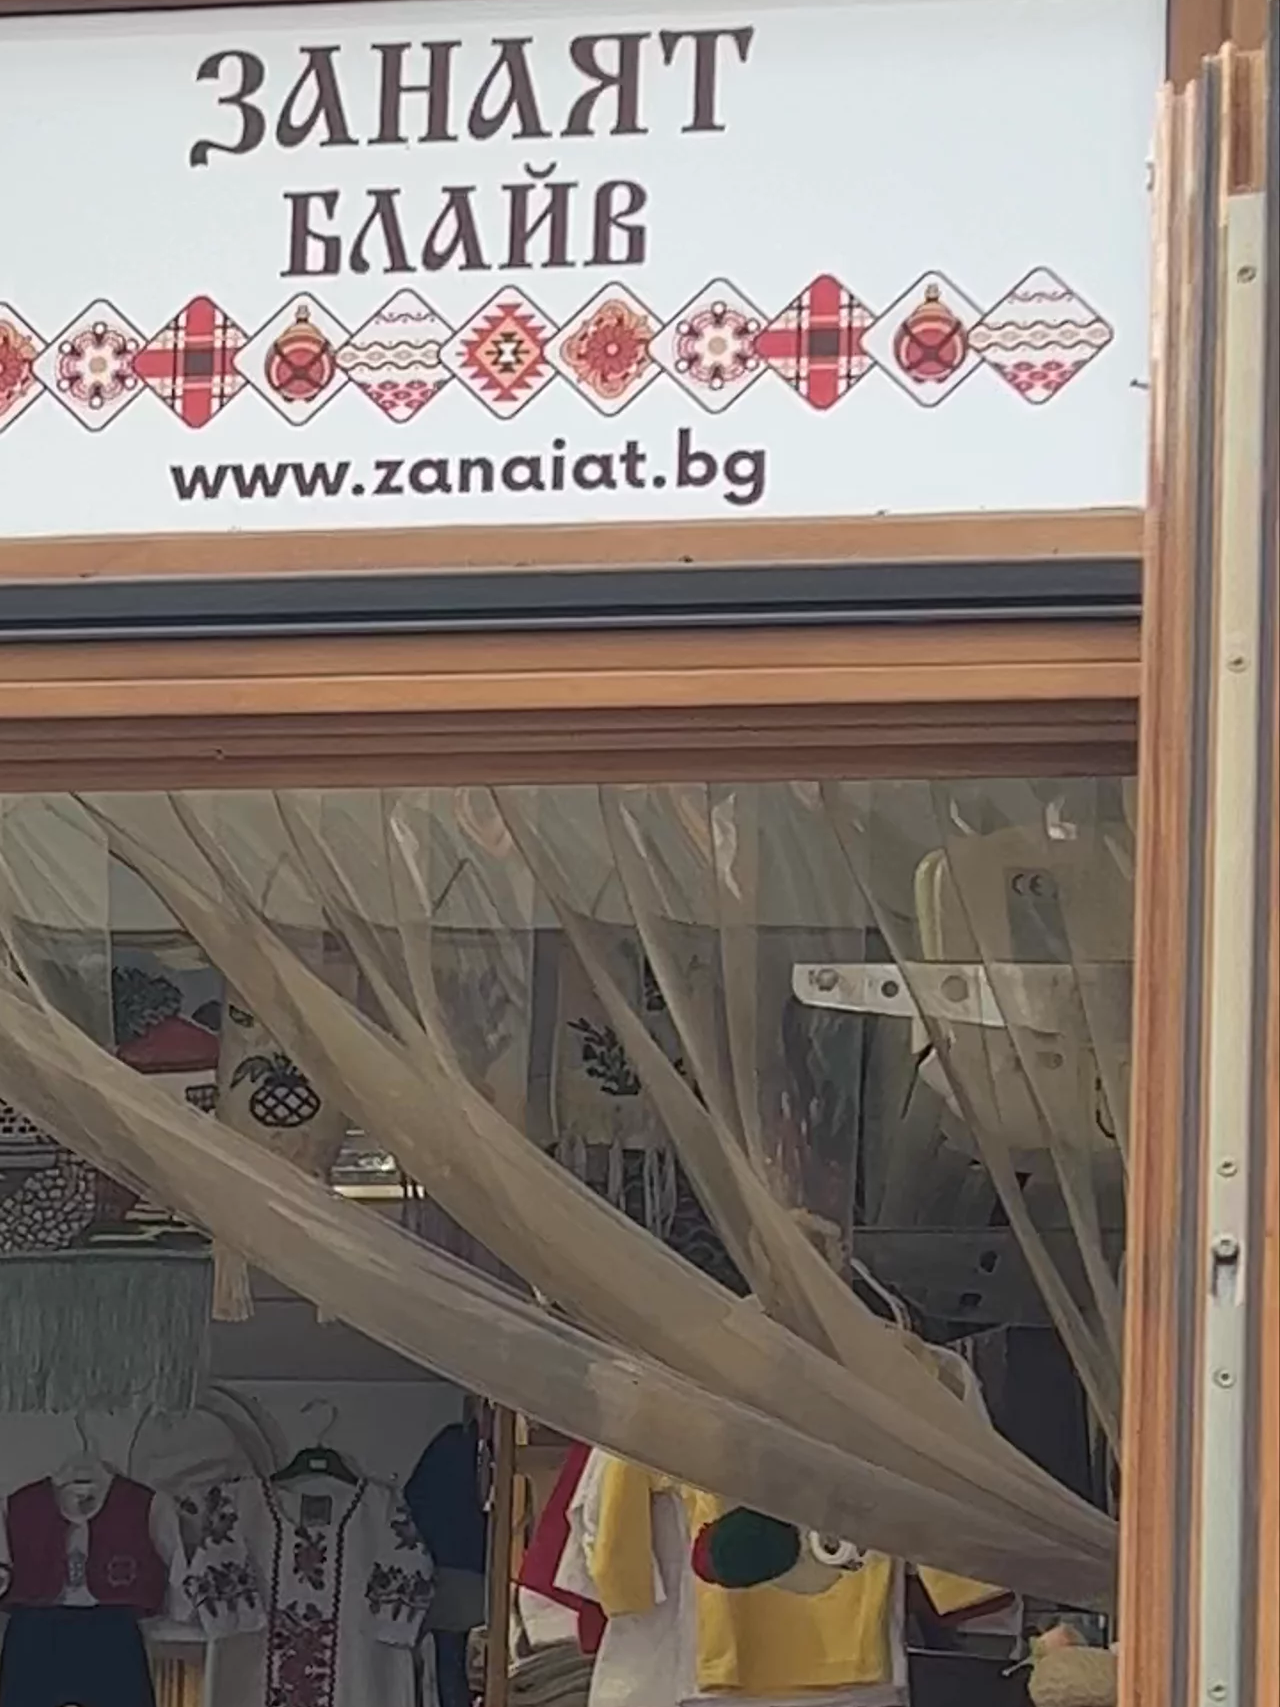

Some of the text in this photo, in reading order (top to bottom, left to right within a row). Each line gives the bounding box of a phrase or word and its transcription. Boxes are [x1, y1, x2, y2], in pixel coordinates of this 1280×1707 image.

[189, 26, 754, 168] ЗАНАЯТ
[280, 162, 648, 278] БЛАЙВ
[169, 428, 767, 505] www.zanaiat.bg
